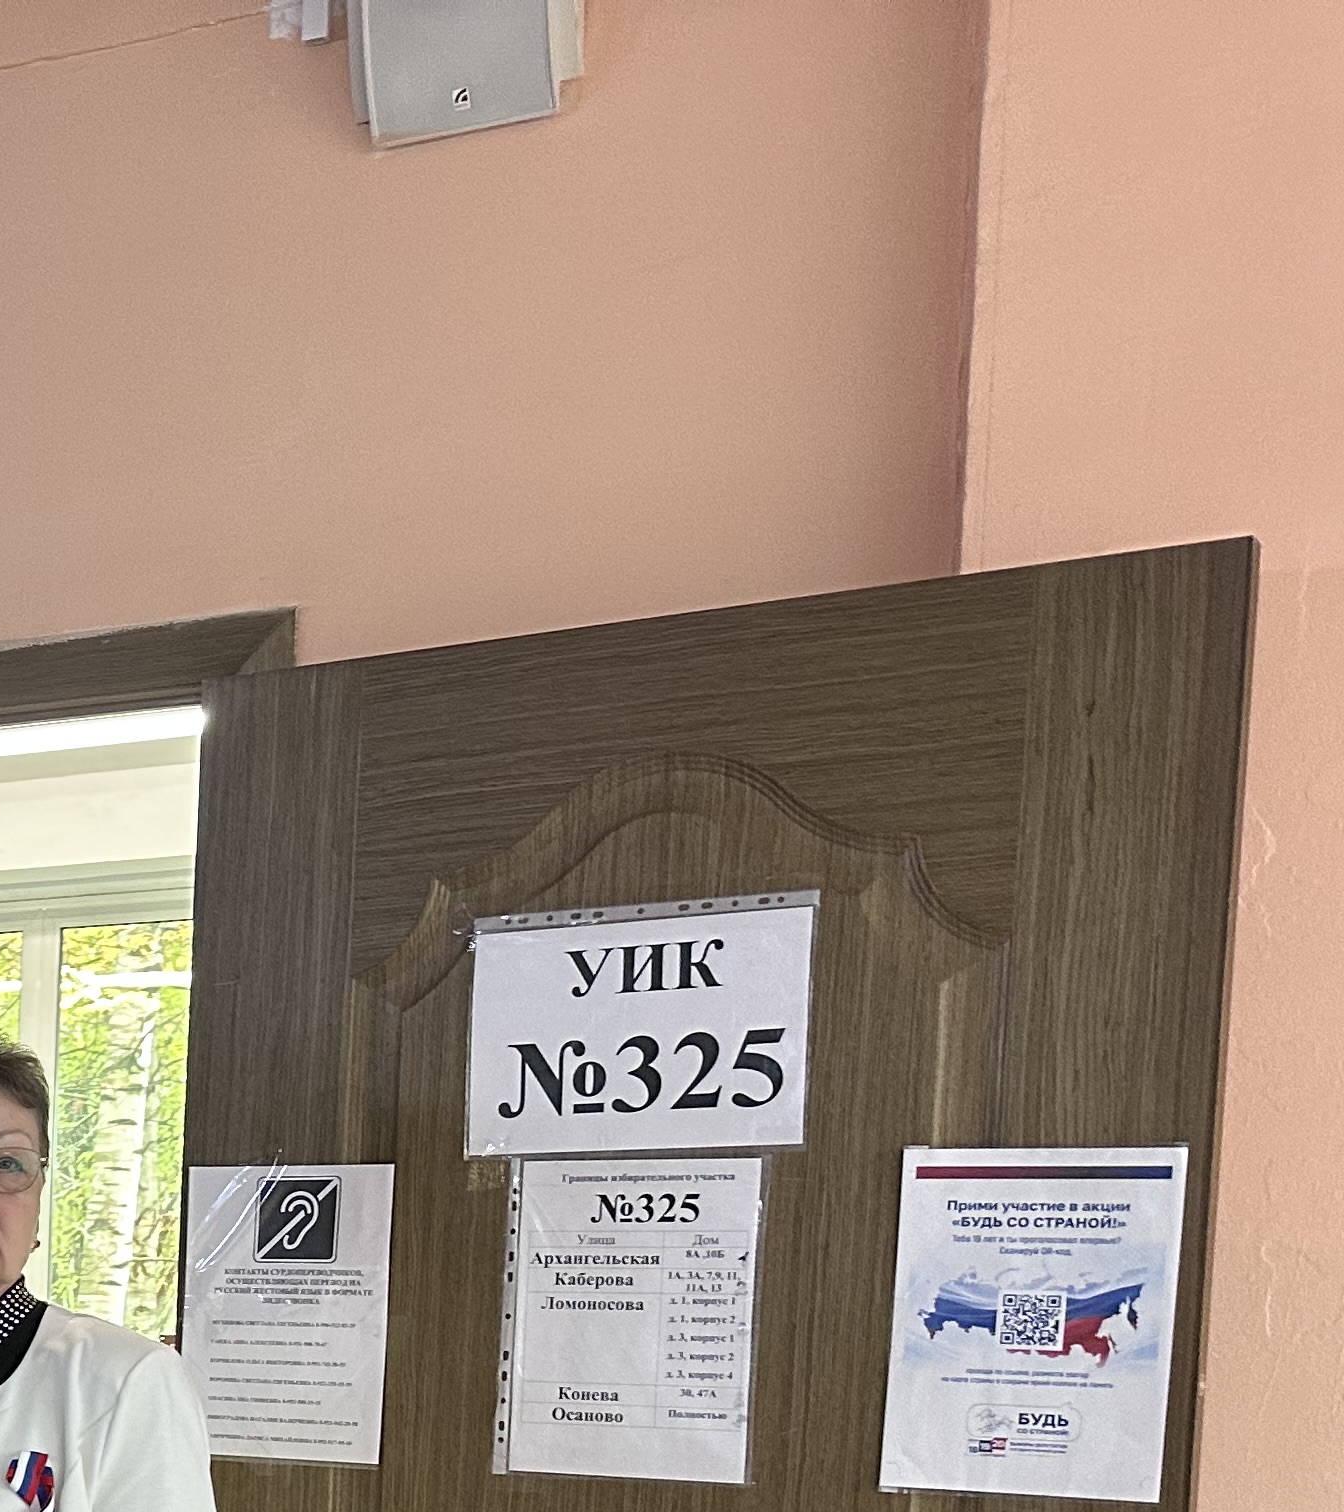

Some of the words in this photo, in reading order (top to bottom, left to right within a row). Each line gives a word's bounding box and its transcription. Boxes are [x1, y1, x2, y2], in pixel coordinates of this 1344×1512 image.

[566, 938, 724, 998] УИК
[498, 1027, 786, 1119] №325
[694, 1173, 735, 1183] участка
[590, 1193, 700, 1223] №325
[947, 1200, 998, 1213] Прими
[1002, 1202, 1066, 1214] участие
[1069, 1202, 1078, 1212] в
[1082, 1202, 1131, 1213] акции
[952, 1216, 1003, 1229] «БУДЬ
[1007, 1217, 1029, 1228] СО
[1033, 1214, 1127, 1229] СТРАНОЙ!»
[577, 1234, 616, 1245] Улица
[692, 1234, 719, 1246] Дом
[530, 1252, 660, 1268] Архангельская
[554, 1272, 634, 1289] Каберова
[541, 1296, 644, 1311] Ломоносова
[558, 1386, 619, 1401] Конева
[552, 1407, 624, 1422] Осаново
[1018, 1413, 1069, 1428] БУДЬ
